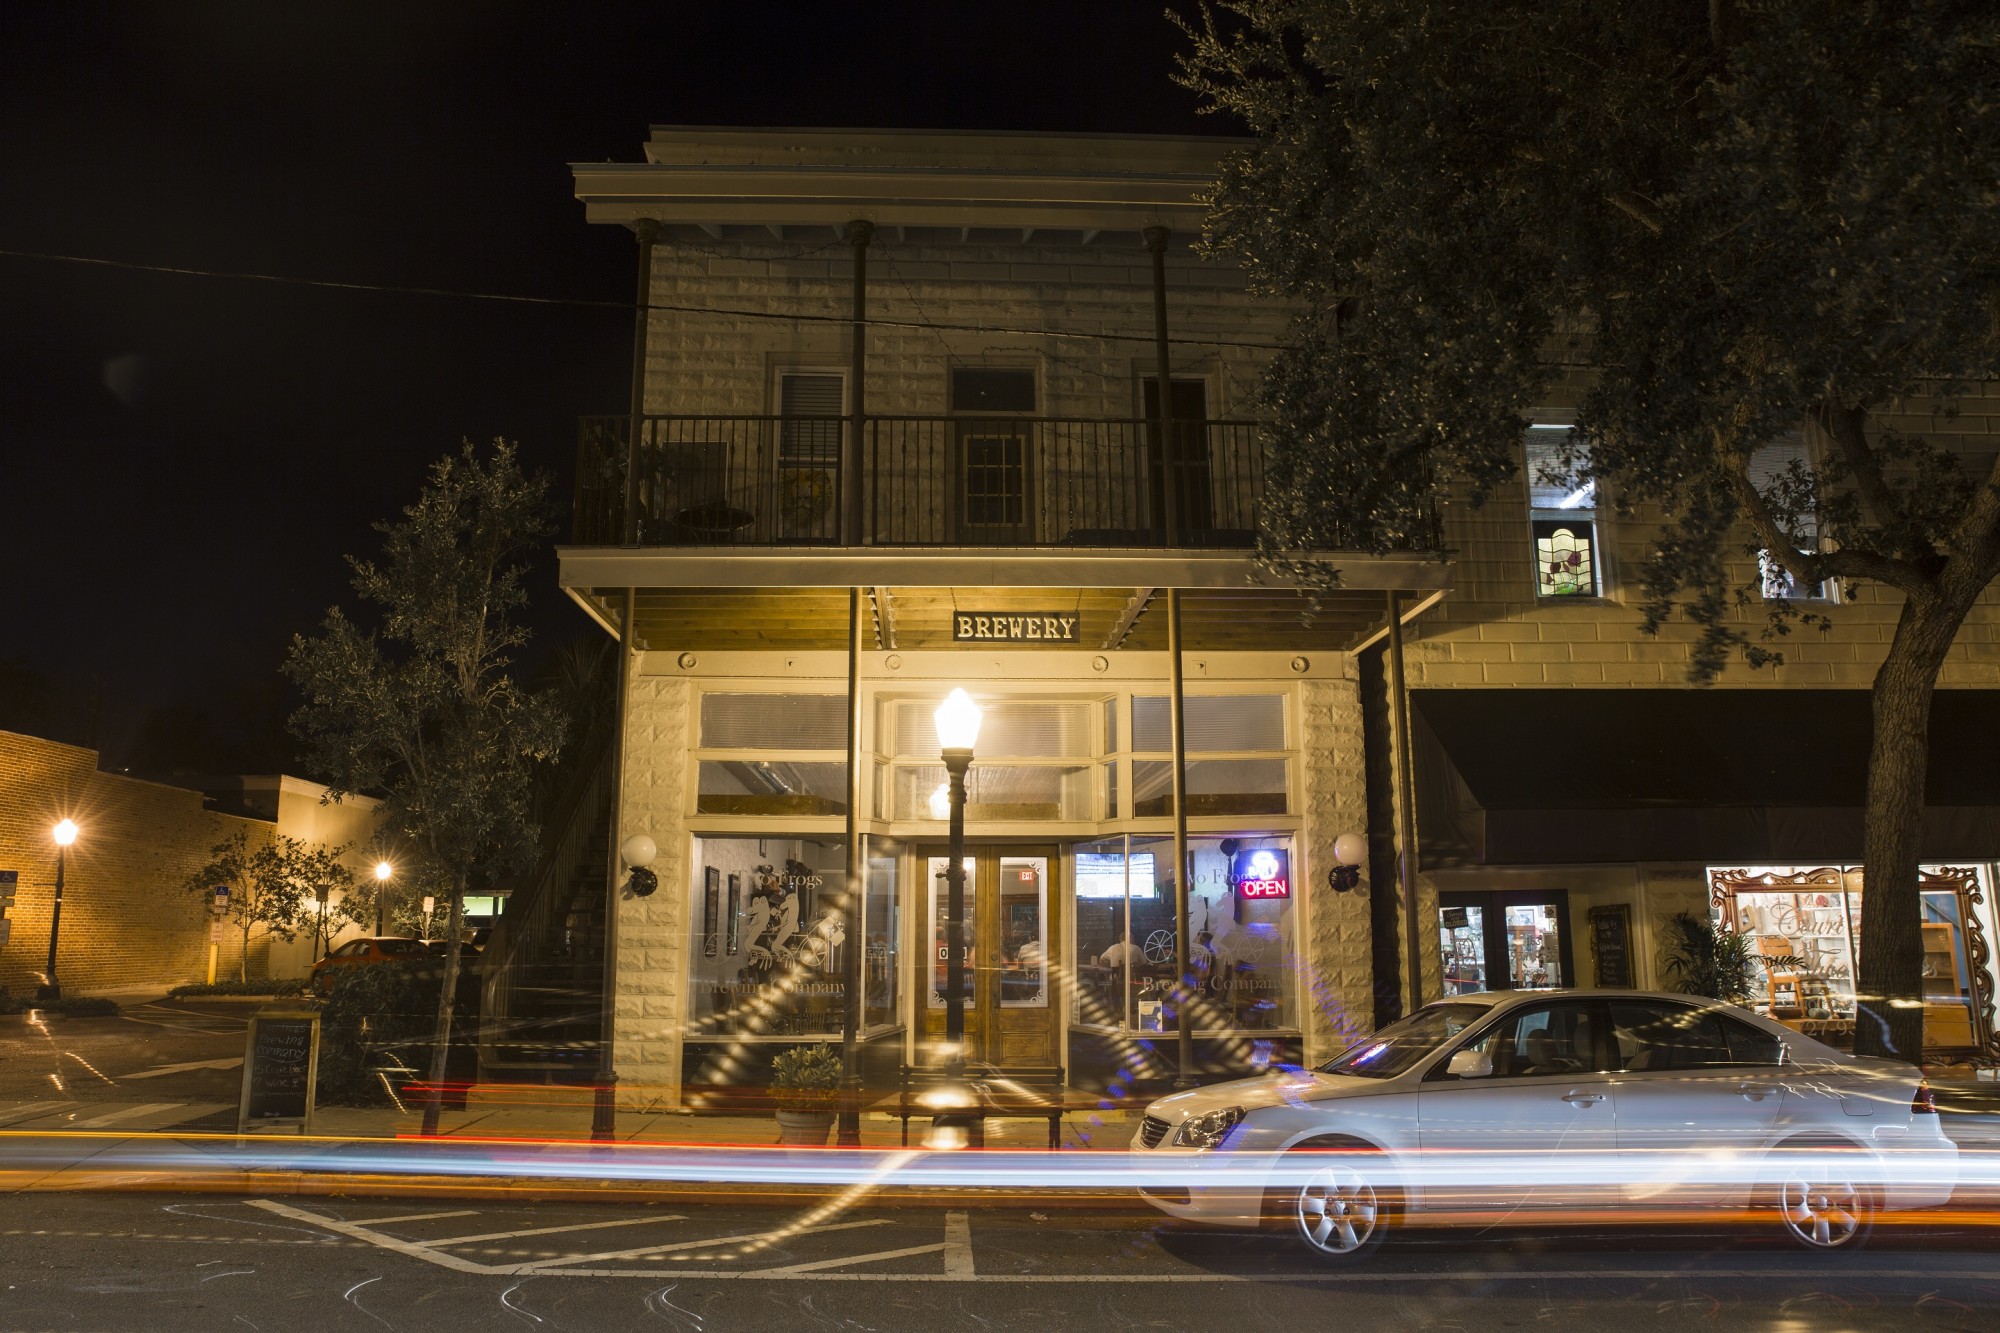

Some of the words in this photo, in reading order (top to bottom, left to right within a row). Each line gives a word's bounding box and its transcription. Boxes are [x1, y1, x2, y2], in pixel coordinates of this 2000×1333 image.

[958, 616, 1076, 639] BREWERY
[1169, 868, 1206, 884] To
[1244, 880, 1286, 896] OPEN
[1445, 919, 1468, 928] CLOSED
[701, 979, 768, 997] Brewin
